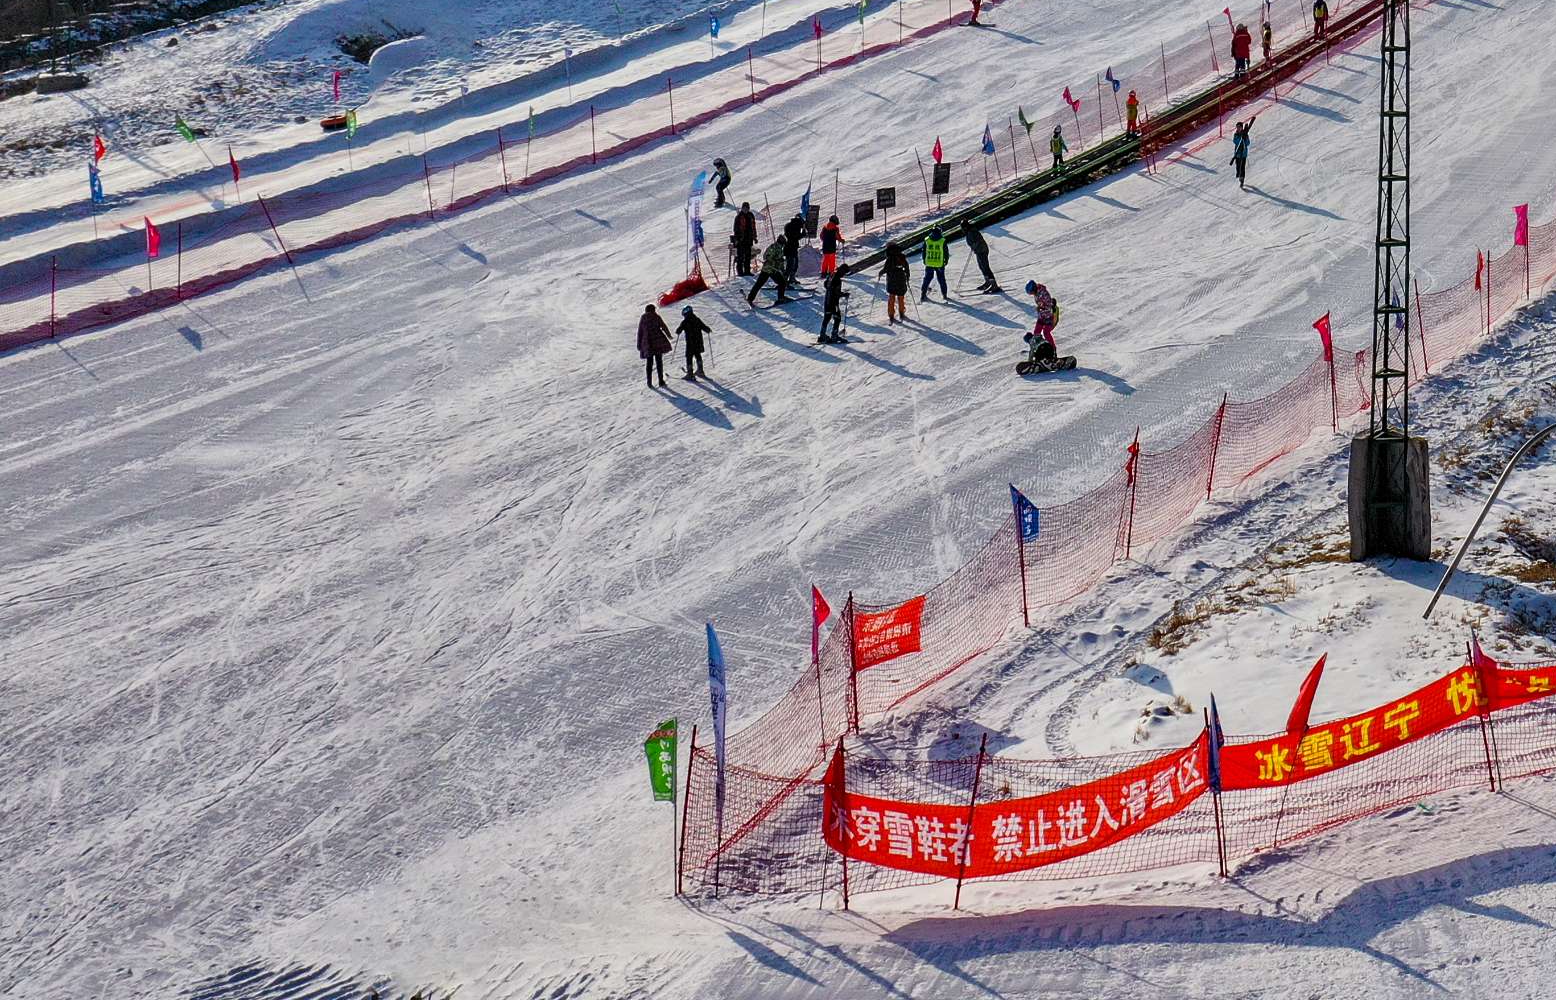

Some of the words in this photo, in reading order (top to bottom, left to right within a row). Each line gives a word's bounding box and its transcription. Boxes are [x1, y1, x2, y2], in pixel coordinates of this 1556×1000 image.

[1255, 699, 1420, 782] 冰雪辽宁
[991, 744, 1205, 862] 禁止进入滑雪区
